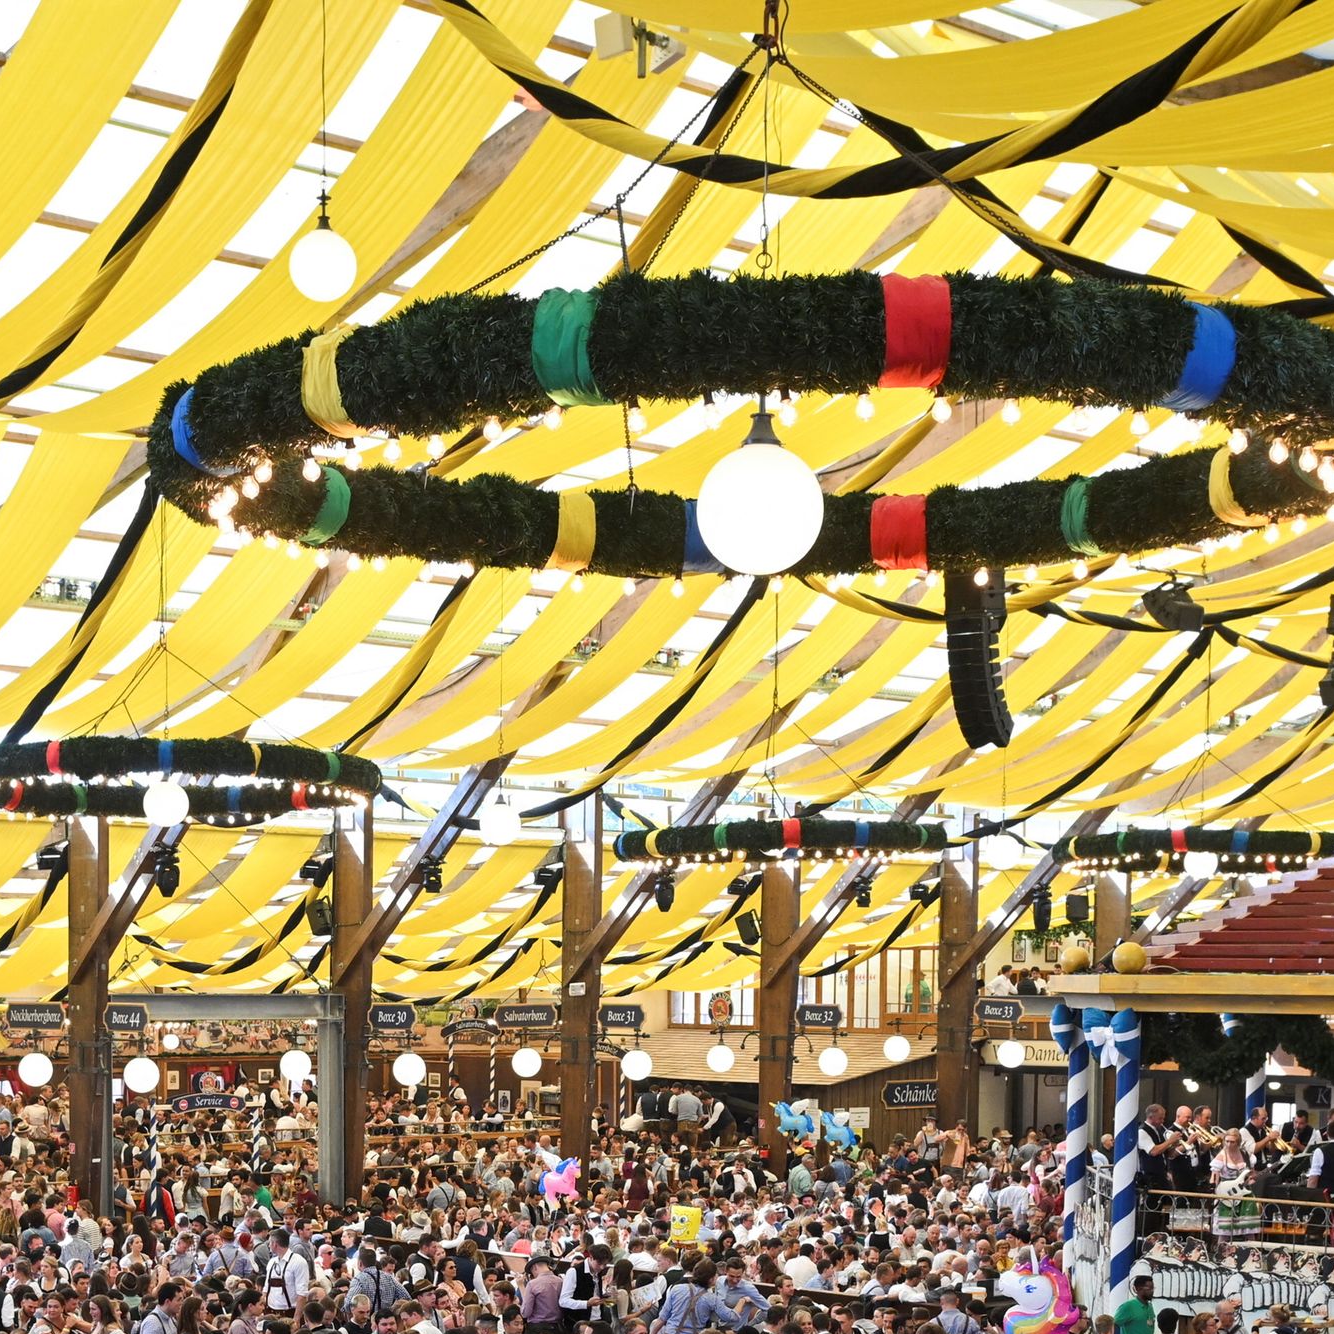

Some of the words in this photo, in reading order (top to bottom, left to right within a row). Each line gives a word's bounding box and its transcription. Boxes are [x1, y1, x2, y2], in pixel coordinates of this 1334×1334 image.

[10, 1009, 61, 1025] Nockherbergboxe
[377, 1011, 396, 1023] Boxe
[396, 1011, 407, 1025] 30
[503, 1011, 547, 1022] Salvatorboxe
[607, 1010, 625, 1022] Boxe
[625, 1010, 635, 1024] 31
[804, 1010, 822, 1021] Boxe
[822, 1010, 833, 1024] 32
[984, 1005, 1002, 1016] Boxe
[1002, 1006, 1013, 1018] 33
[112, 1011, 129, 1024] Boxe
[129, 1012, 140, 1028] 44
[195, 1096, 223, 1106] Service
